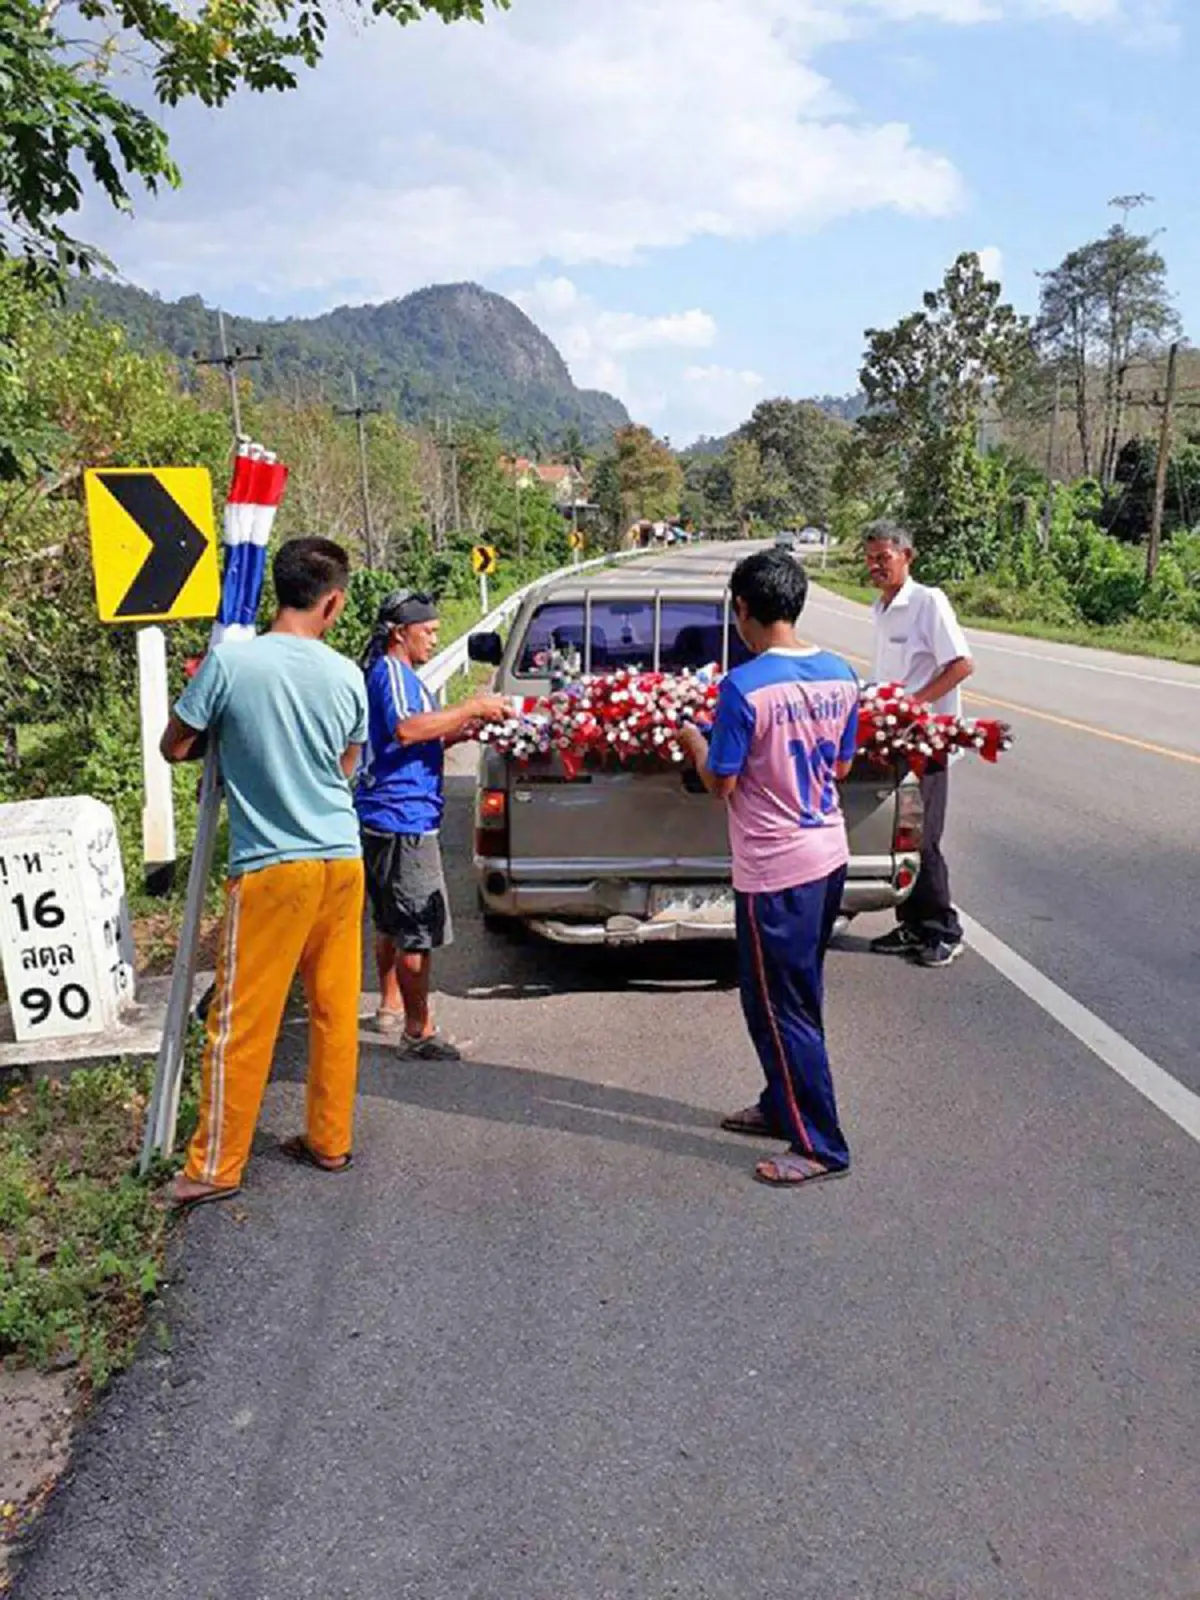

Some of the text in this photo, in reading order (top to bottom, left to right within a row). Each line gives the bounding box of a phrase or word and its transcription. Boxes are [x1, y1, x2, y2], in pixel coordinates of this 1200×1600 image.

[11, 890, 65, 931] 16
[21, 944, 75, 977] สตูล
[20, 983, 90, 1025] 90
